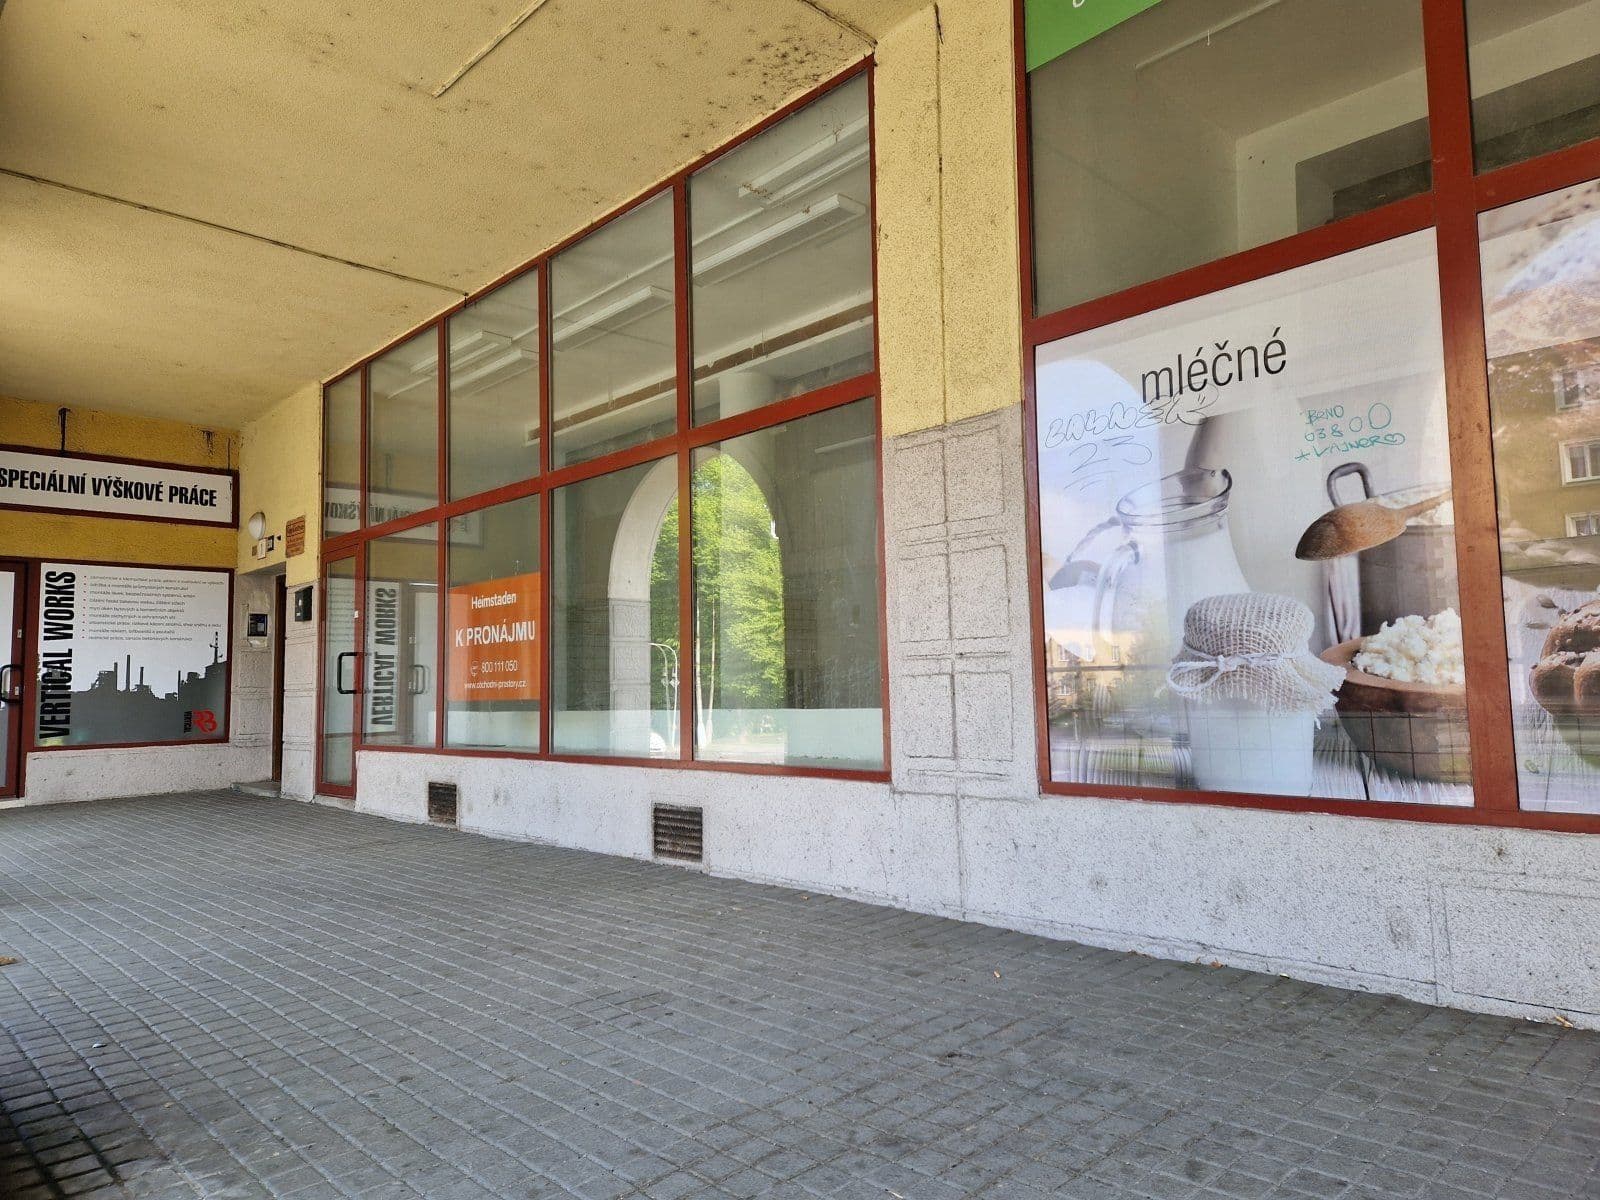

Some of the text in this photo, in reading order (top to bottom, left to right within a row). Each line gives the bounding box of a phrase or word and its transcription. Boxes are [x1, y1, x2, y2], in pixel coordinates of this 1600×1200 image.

[1141, 326, 1287, 403] mléčné
[0, 467, 217, 507] SPECIÁLNÍ VÝŠKOVÉ PRÁCE
[471, 590, 517, 609] Heimstaden
[455, 619, 535, 648] K PRONÁJMU
[39, 570, 76, 739] VERTICAL WORKS
